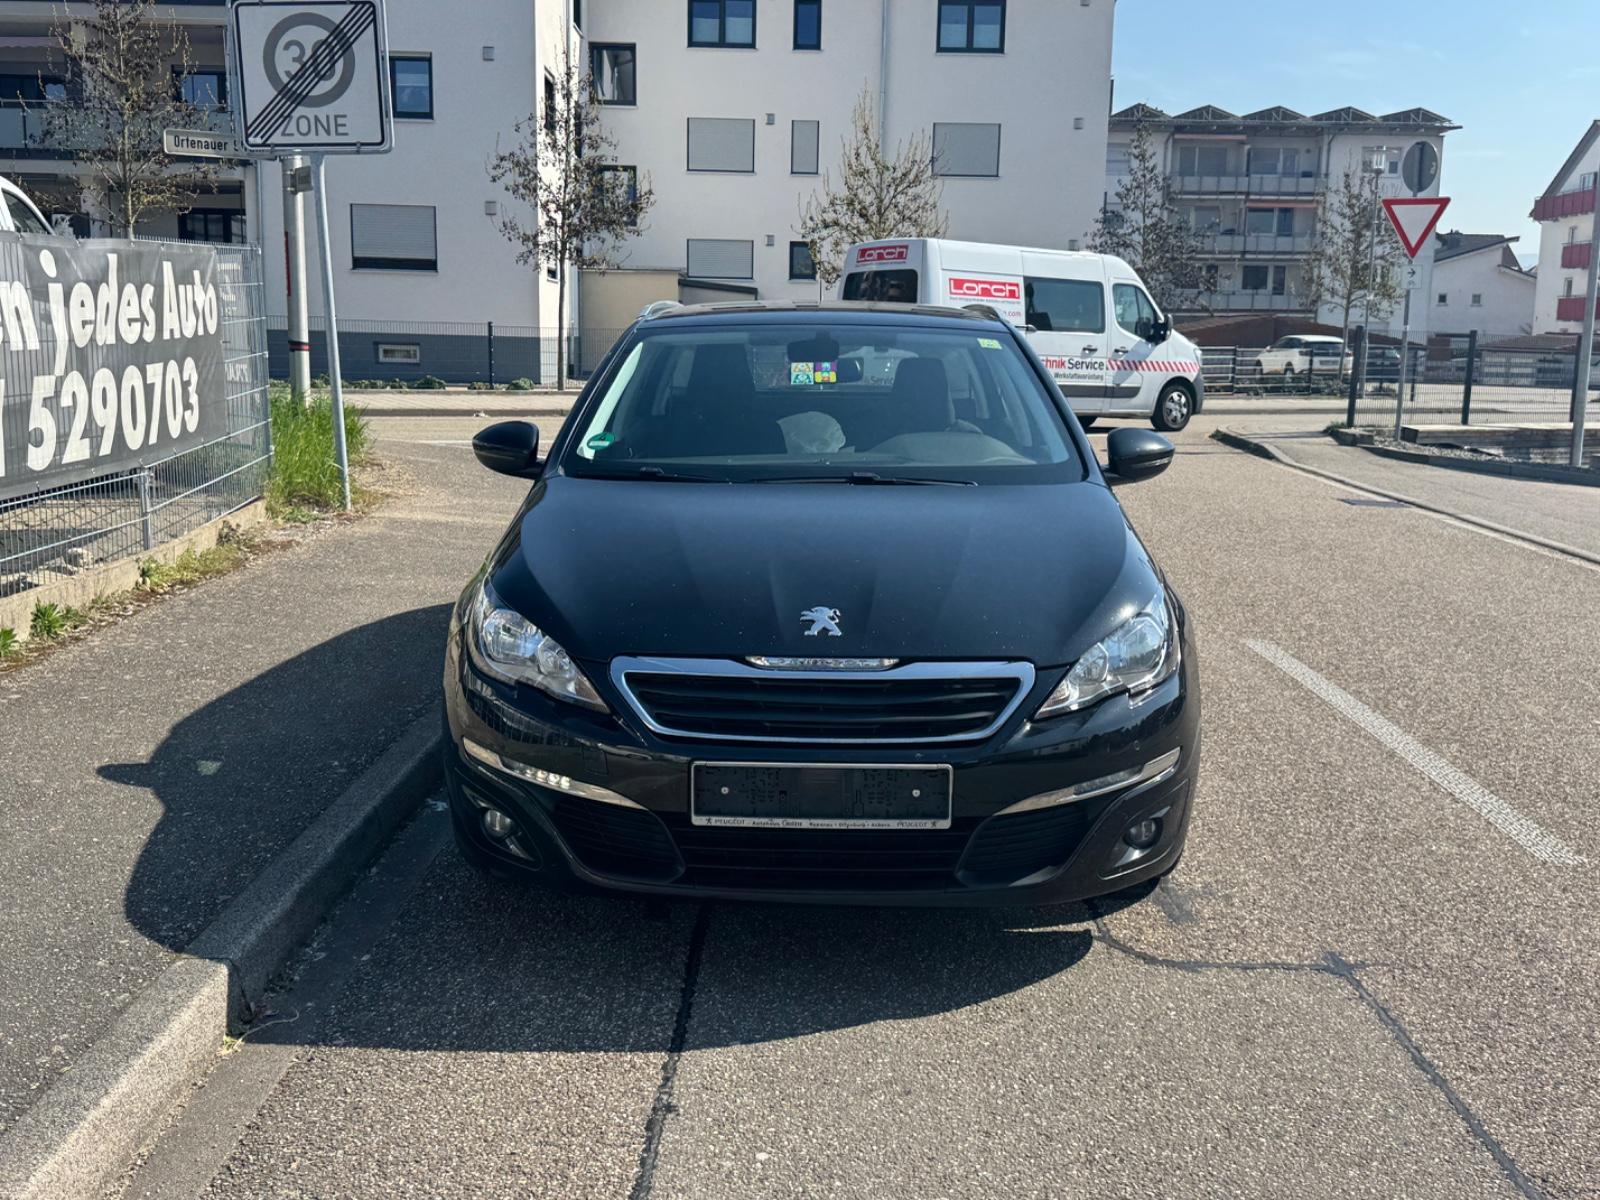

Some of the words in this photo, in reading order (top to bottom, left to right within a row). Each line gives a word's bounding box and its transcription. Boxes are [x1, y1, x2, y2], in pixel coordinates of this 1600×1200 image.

[282, 39, 336, 82] 30
[281, 114, 349, 137] ZONE
[173, 134, 228, 152] Ortenauer
[857, 247, 907, 261] Lorch
[950, 279, 1019, 298] Lorch
[0, 280, 40, 350] n
[39, 249, 156, 377] jedes
[162, 260, 218, 340] Auto
[1067, 357, 1104, 371] Service
[27, 356, 200, 472] 5290703
